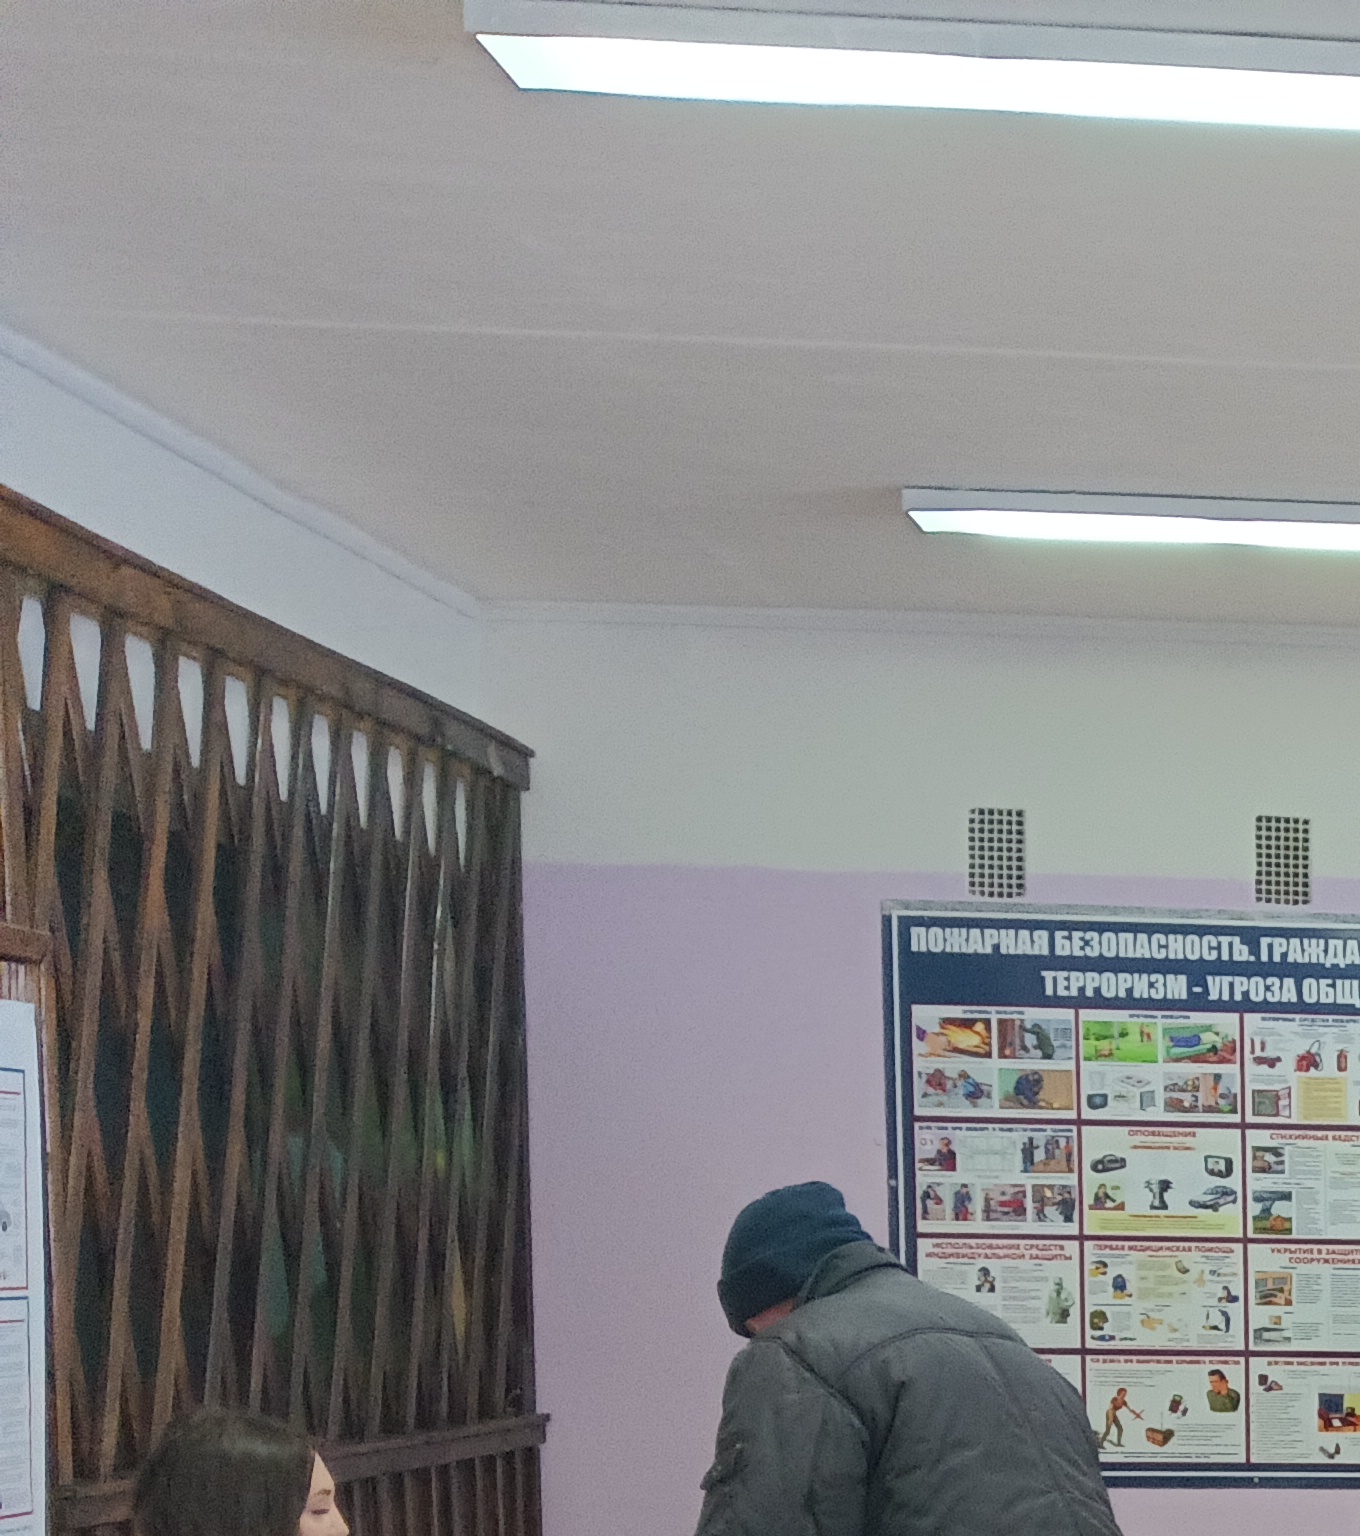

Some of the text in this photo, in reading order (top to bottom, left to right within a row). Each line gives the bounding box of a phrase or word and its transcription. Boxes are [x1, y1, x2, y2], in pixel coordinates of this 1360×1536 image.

[909, 926, 1050, 955] ПОЖАРНАЯ
[1054, 930, 1256, 961] БЕЗОПАСНОСТЬ.
[1040, 970, 1188, 1000] ТЕРРОРИЗМ
[1206, 975, 1298, 1003] УГРОЗА
[1270, 1247, 1315, 1256] УКРЫТИЕ
